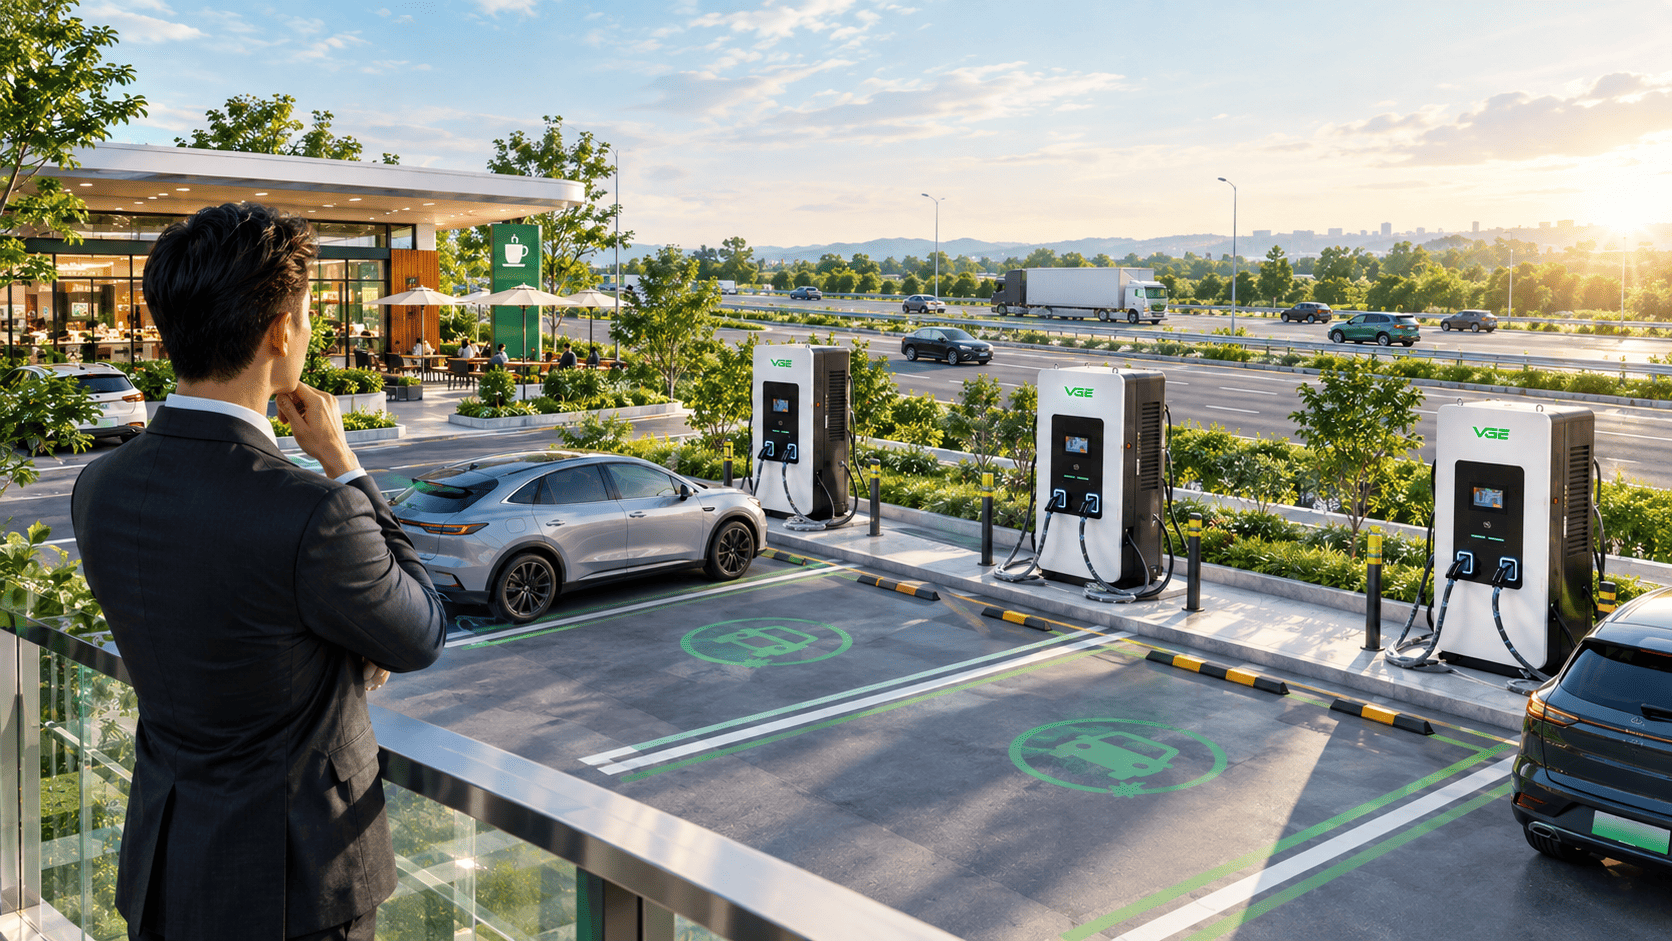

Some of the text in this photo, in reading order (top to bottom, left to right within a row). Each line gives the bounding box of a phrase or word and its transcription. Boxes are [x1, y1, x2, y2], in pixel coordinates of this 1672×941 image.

[770, 358, 792, 368] VGE
[1064, 386, 1094, 398] VGE
[1472, 426, 1510, 440] VGE
